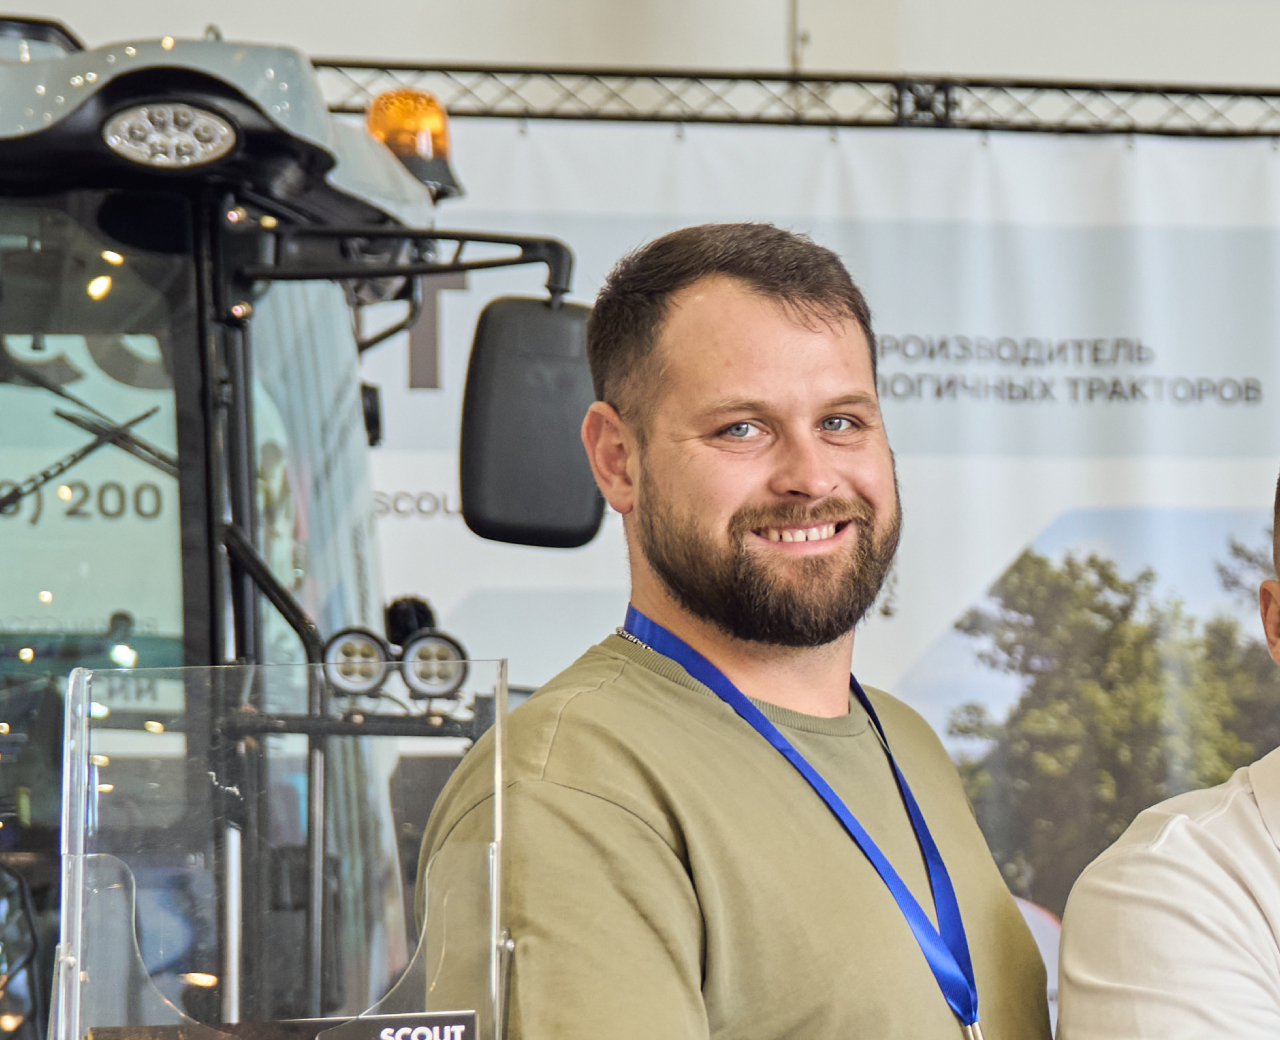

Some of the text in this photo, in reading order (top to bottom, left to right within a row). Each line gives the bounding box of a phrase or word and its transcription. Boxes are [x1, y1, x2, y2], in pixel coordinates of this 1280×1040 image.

[877, 334, 1153, 367] РОИЗВОДИТЕЛЬ
[1064, 375, 1263, 405] ТРАКТОРОВ
[65, 480, 163, 520] 200
